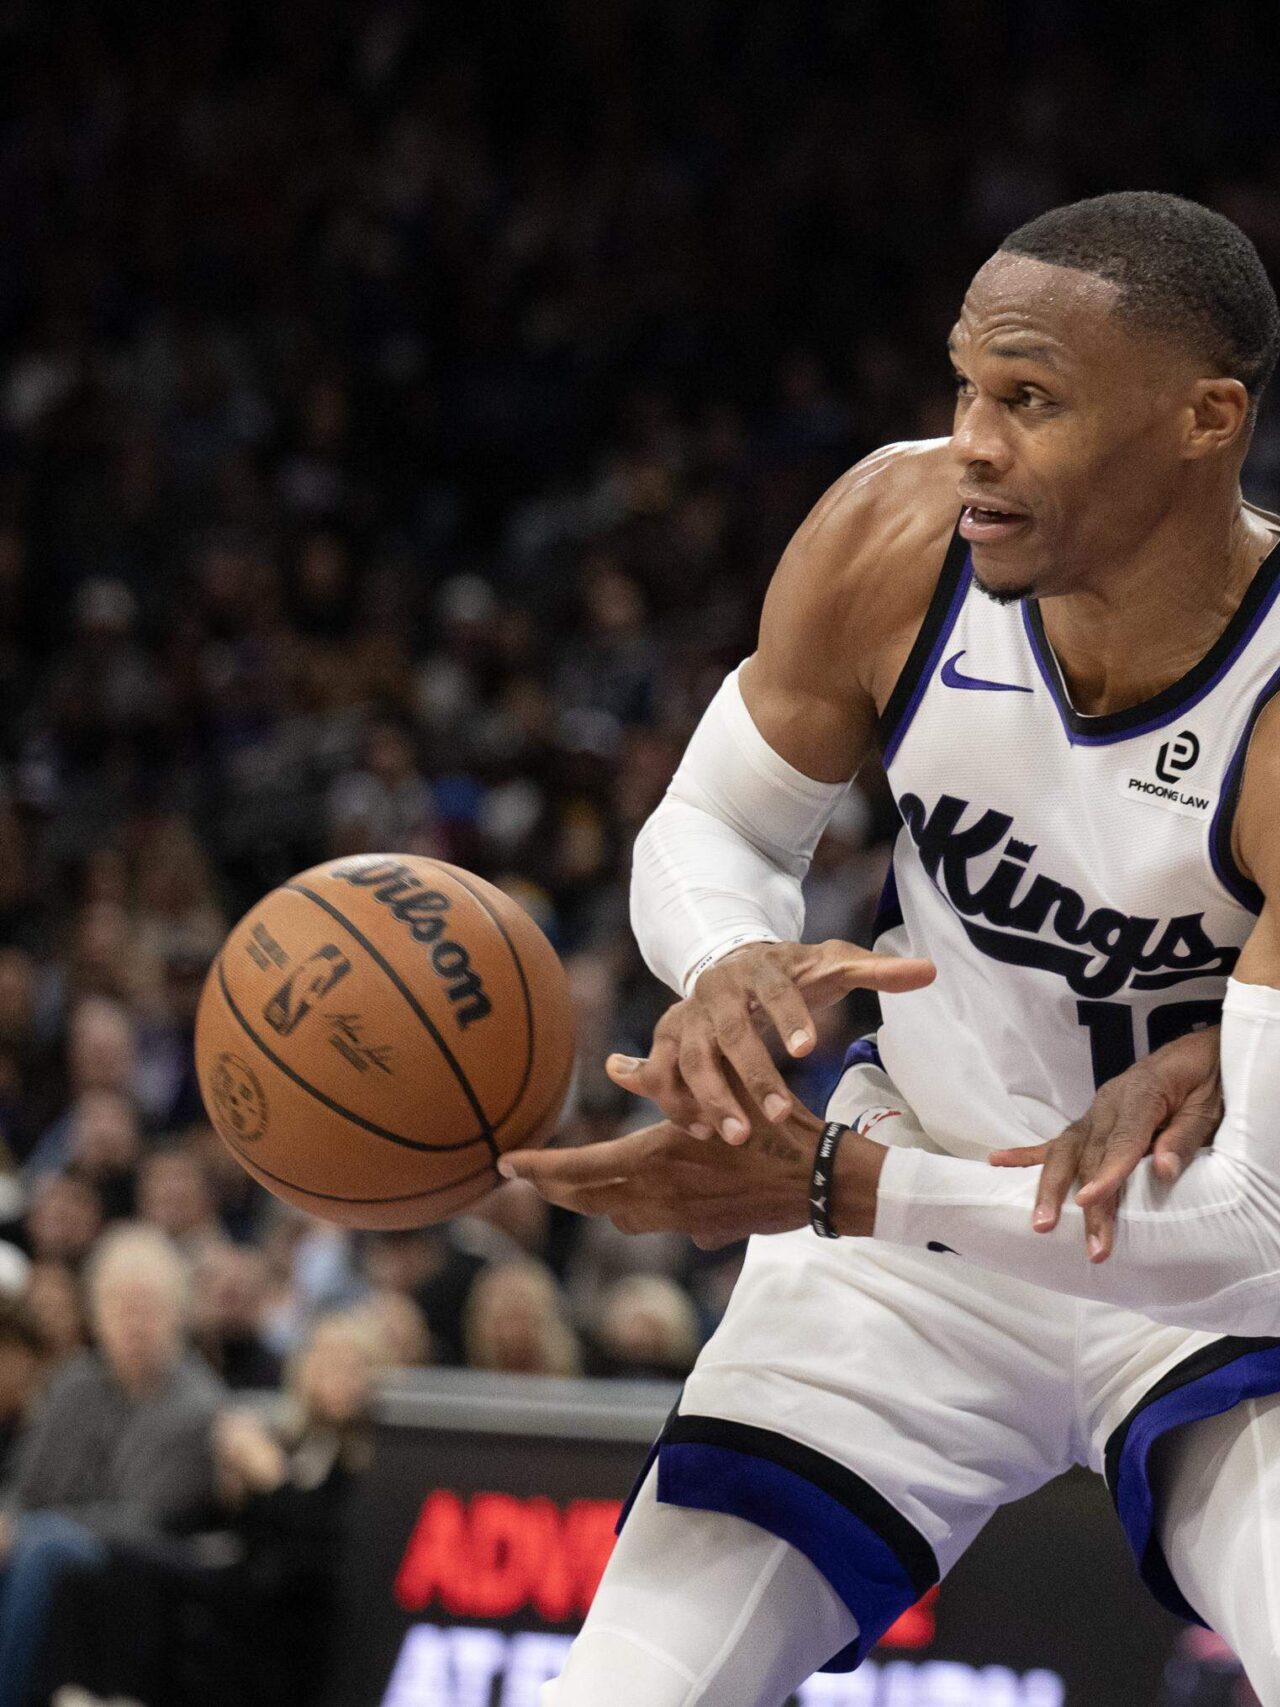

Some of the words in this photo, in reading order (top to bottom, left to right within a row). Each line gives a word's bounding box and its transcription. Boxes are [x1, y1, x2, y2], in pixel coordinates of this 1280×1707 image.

[1128, 778, 1179, 802] PHOONG
[1180, 793, 1210, 810] LAW
[331, 861, 493, 1032] Wilson
[899, 791, 1242, 999] Kings
